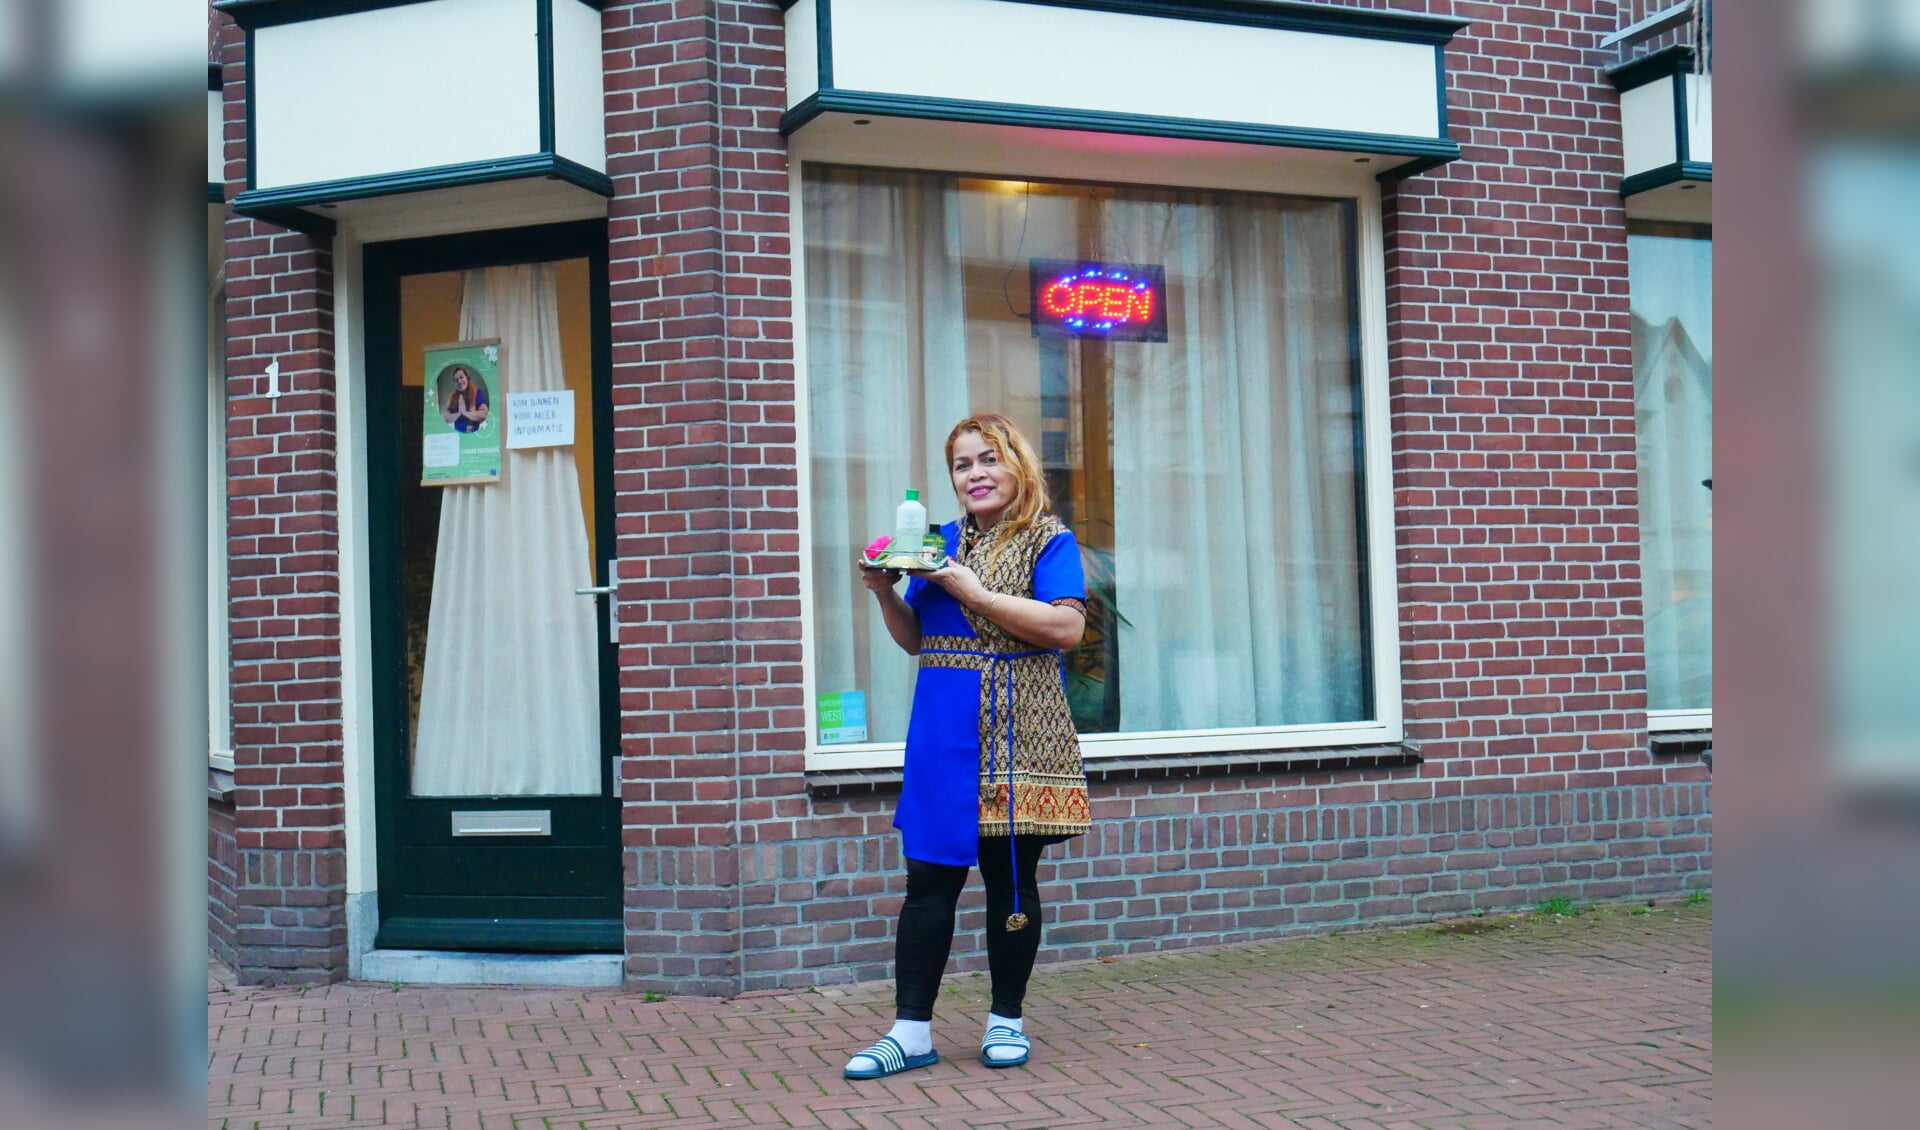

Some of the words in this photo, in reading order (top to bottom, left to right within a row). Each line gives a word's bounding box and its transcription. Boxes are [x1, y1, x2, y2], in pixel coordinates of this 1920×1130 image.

[1046, 283, 1151, 321] OPEN
[265, 361, 281, 398] 1
[534, 410, 557, 420] MEER
[513, 424, 564, 436] INFORMATIE
[821, 708, 864, 722] WESTLAND
